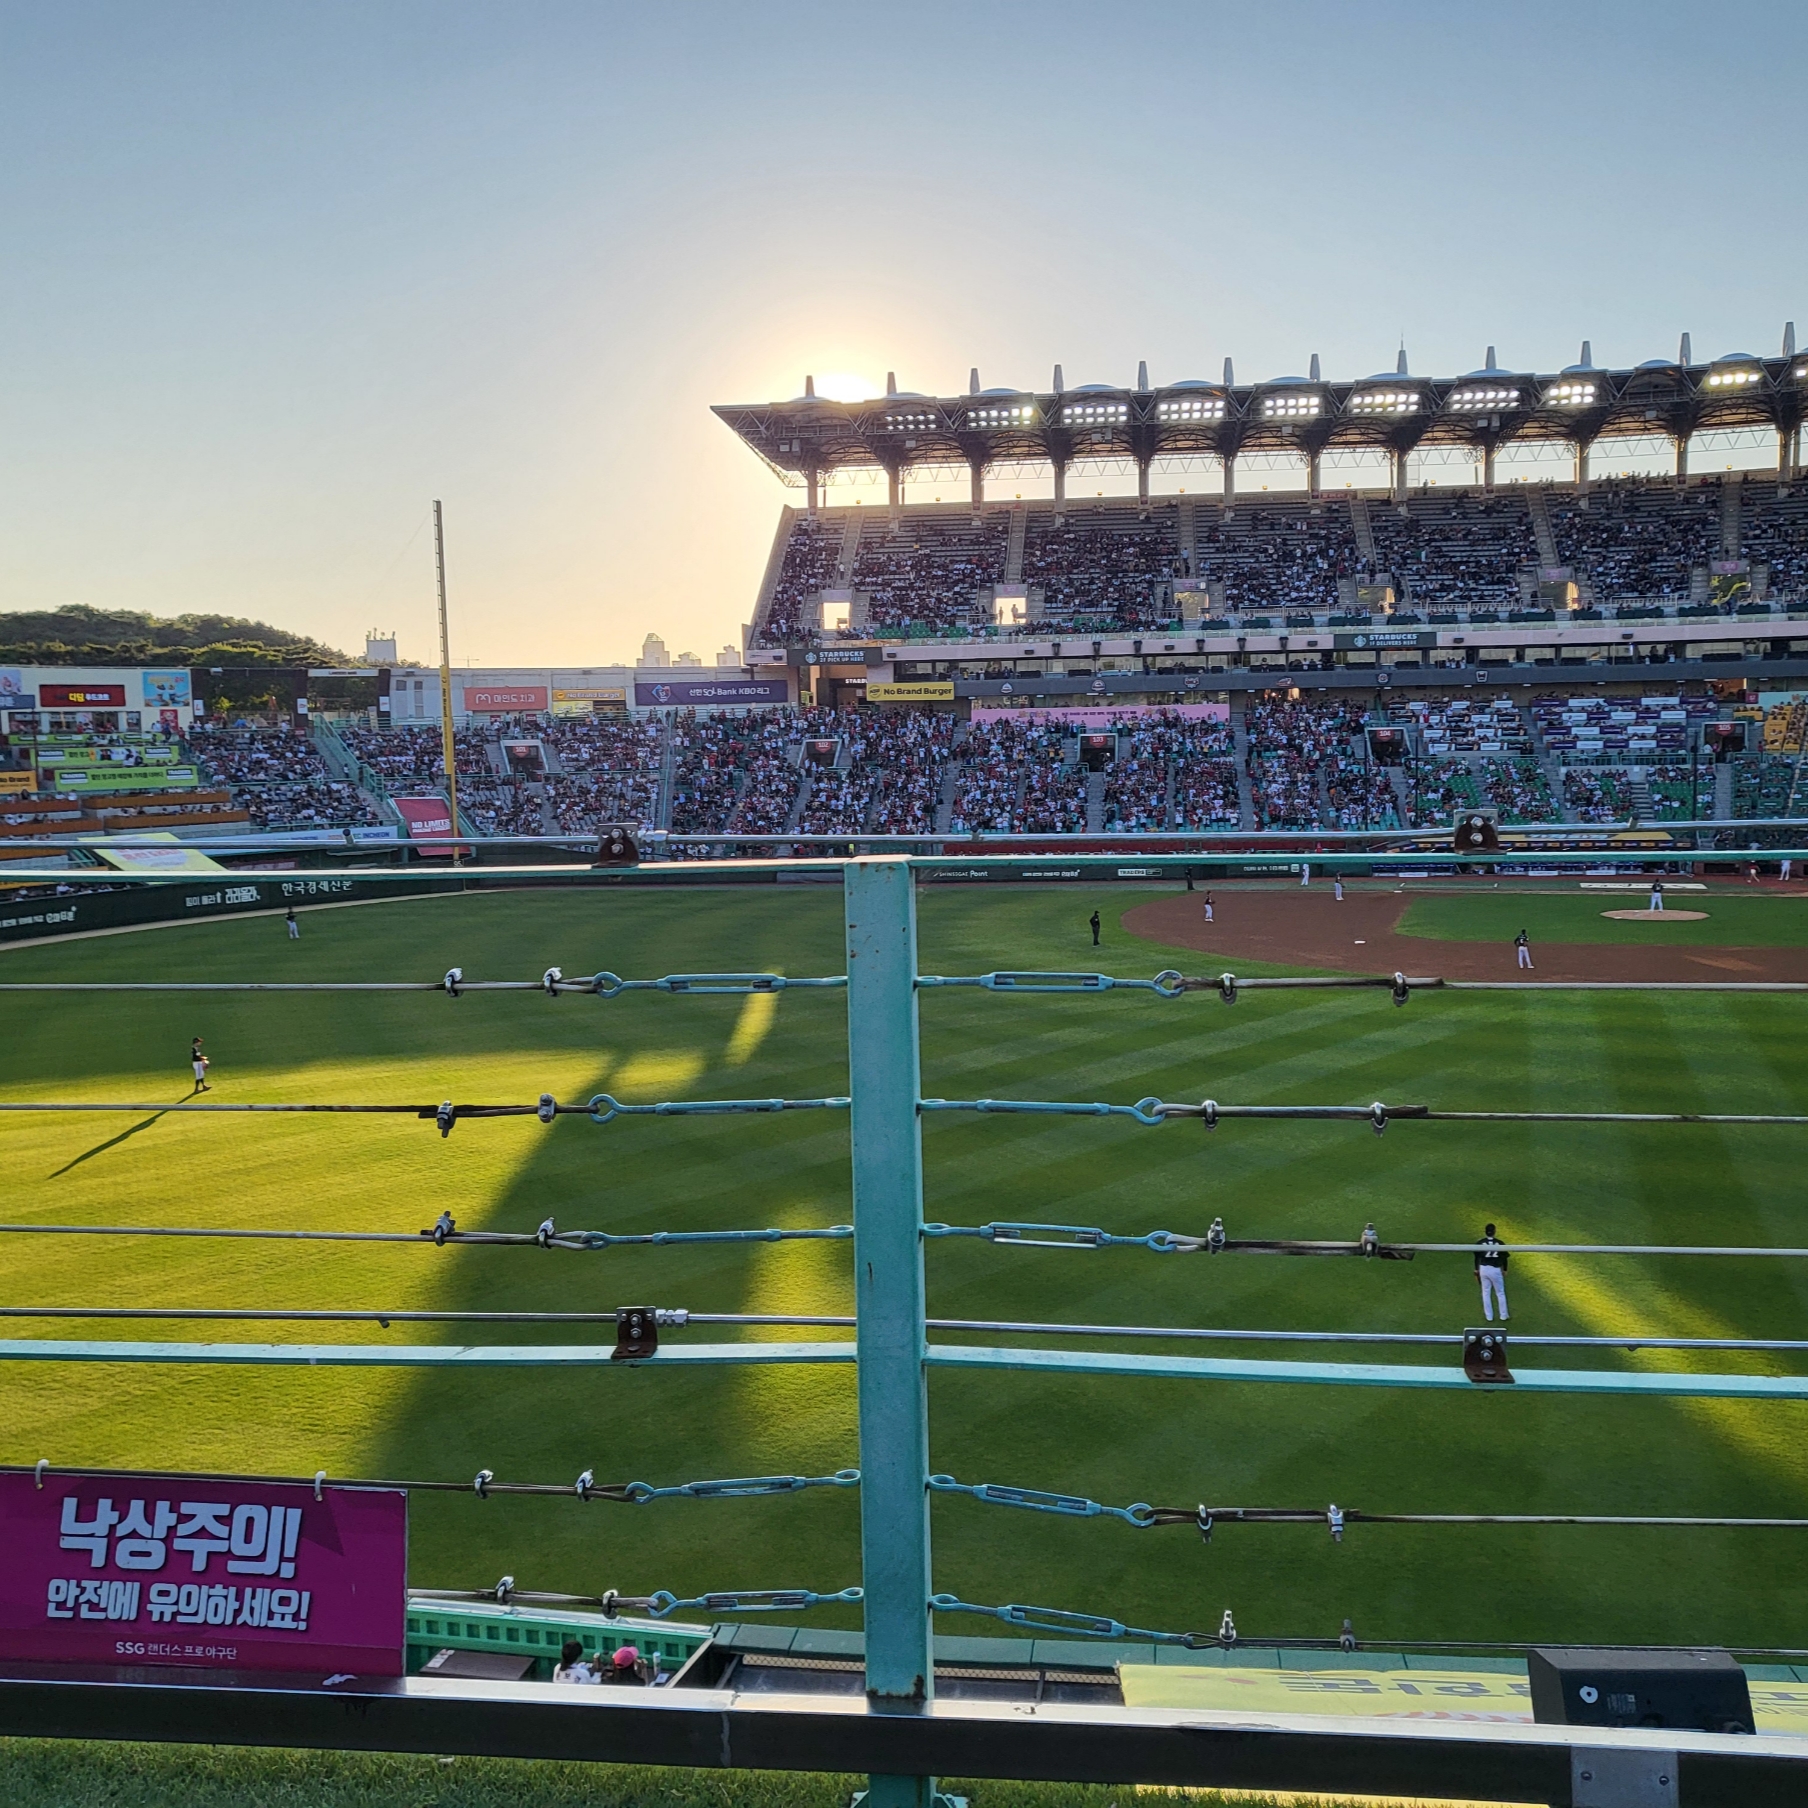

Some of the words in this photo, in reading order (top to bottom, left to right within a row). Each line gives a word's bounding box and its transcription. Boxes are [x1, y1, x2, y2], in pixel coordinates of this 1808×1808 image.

[689, 688, 702, 697] 신한
[717, 688, 737, 696] Bank
[757, 687, 770, 695] 리그
[923, 687, 953, 696] Burger
[493, 694, 518, 703] 마인드
[520, 694, 535, 703] 치과
[411, 821, 423, 829] NO
[424, 818, 450, 828] LIMITS
[363, 831, 390, 839] INCHEON
[969, 869, 989, 878] Point
[281, 880, 353, 897] 한국경제신문
[59, 1496, 303, 1579] 낙상주의!
[46, 1578, 140, 1621] 안전에
[146, 1582, 311, 1631] 유의하세요!
[115, 1641, 146, 1655] SSG
[147, 1642, 182, 1657] 랜더스
